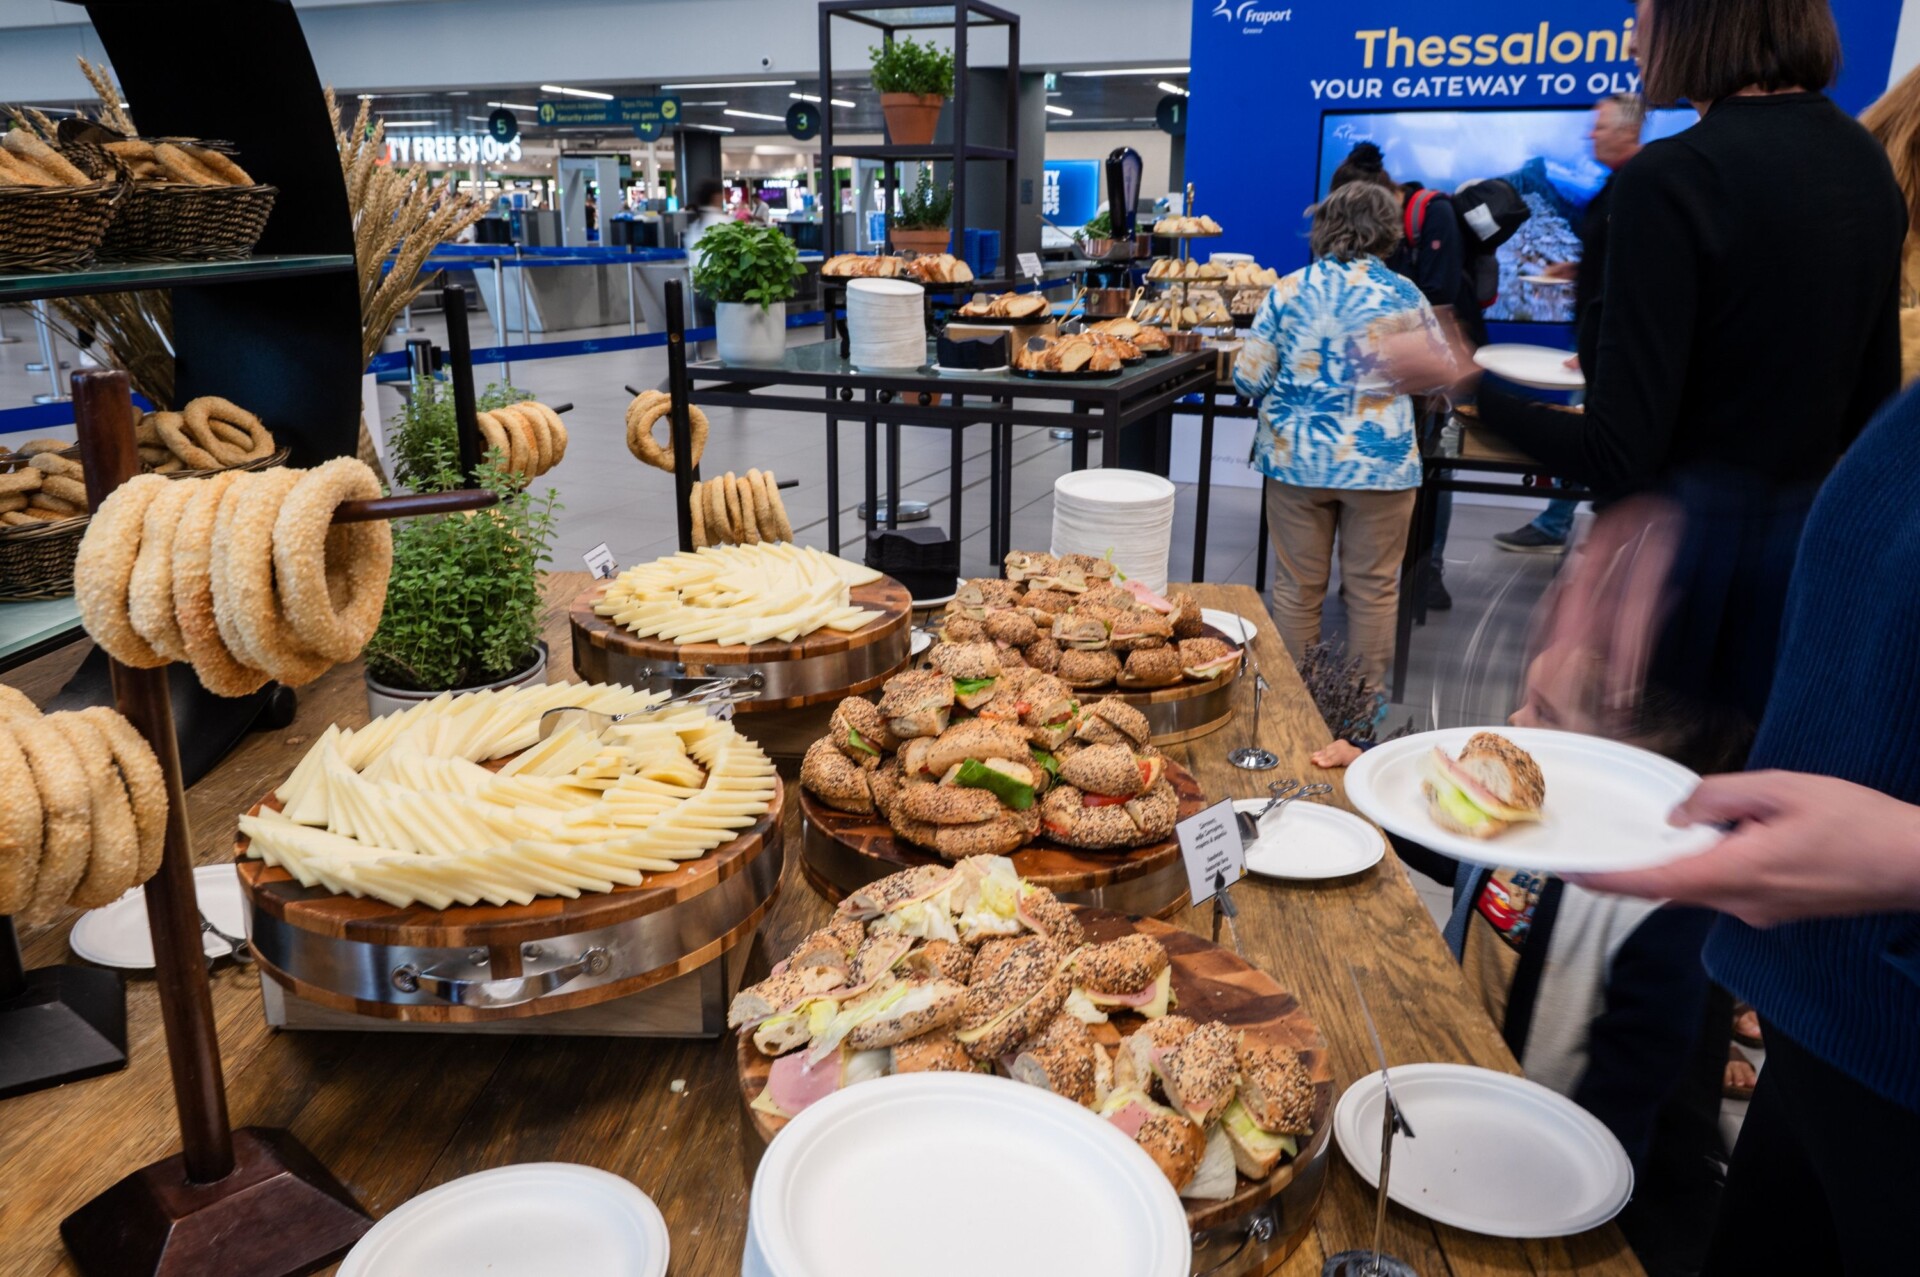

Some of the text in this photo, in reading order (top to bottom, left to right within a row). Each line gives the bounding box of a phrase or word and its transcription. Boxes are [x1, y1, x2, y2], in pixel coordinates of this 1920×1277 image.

[1245, 8, 1292, 26] Fraport
[1355, 17, 1635, 69] Thessaloni
[1310, 72, 1641, 100] YOUR GATEWAY TO OLY
[797, 113, 808, 130] 3
[1171, 104, 1179, 124] 1
[496, 118, 508, 135] 5
[412, 136, 457, 162] FREE
[1043, 170, 1060, 185] TY
[1043, 185, 1060, 202] EE
